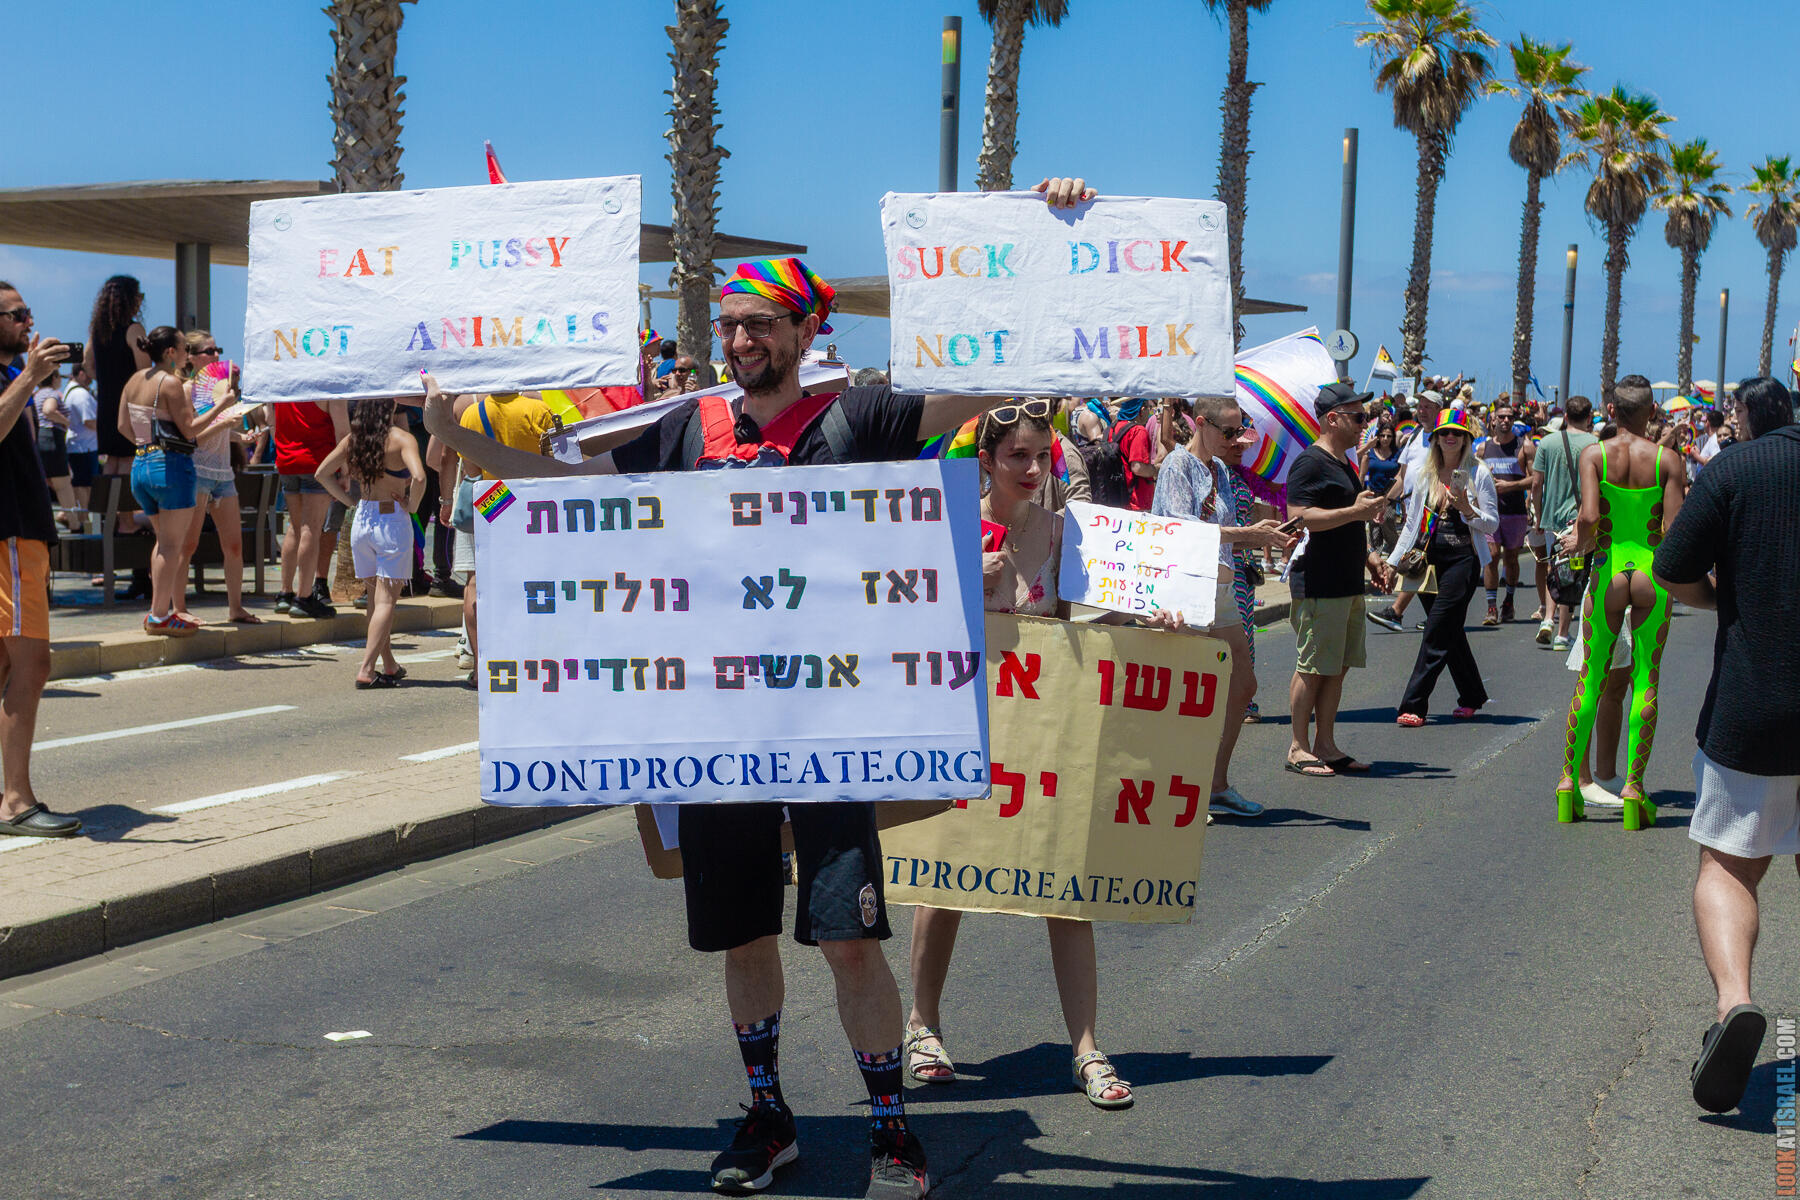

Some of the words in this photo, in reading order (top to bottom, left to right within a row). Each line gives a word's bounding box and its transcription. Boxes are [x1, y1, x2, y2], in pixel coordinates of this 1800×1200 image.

[317, 245, 400, 278] EAT
[449, 236, 571, 270] PUSSY
[897, 243, 1016, 280] SUCK
[1067, 240, 1190, 275] DICK
[273, 325, 355, 361] NOT
[405, 311, 610, 351] ANIMALS
[915, 329, 1010, 368] NOT
[1072, 323, 1197, 360] MILK
[480, 486, 505, 508] VEGAN
[526, 496, 665, 534] בתחת
[730, 487, 942, 527] מזדיינים
[1089, 515, 1182, 536] טבעונות
[1115, 540, 1133, 551] גם
[1087, 558, 1125, 572] החיים
[1150, 545, 1165, 556] כי
[523, 571, 690, 614] נולדים
[741, 568, 807, 610] לא
[861, 568, 939, 604] ואז
[1098, 577, 1155, 594] מגיעות
[487, 656, 687, 693] מזדיינים
[713, 653, 861, 690] אנשים
[892, 650, 981, 691] עוד
[1097, 659, 1218, 718] עשו
[491, 749, 984, 793] DONTPROCREATE.ORG
[1114, 775, 1200, 827] לא
[883, 855, 1197, 907] TPROCREATE.ORG
